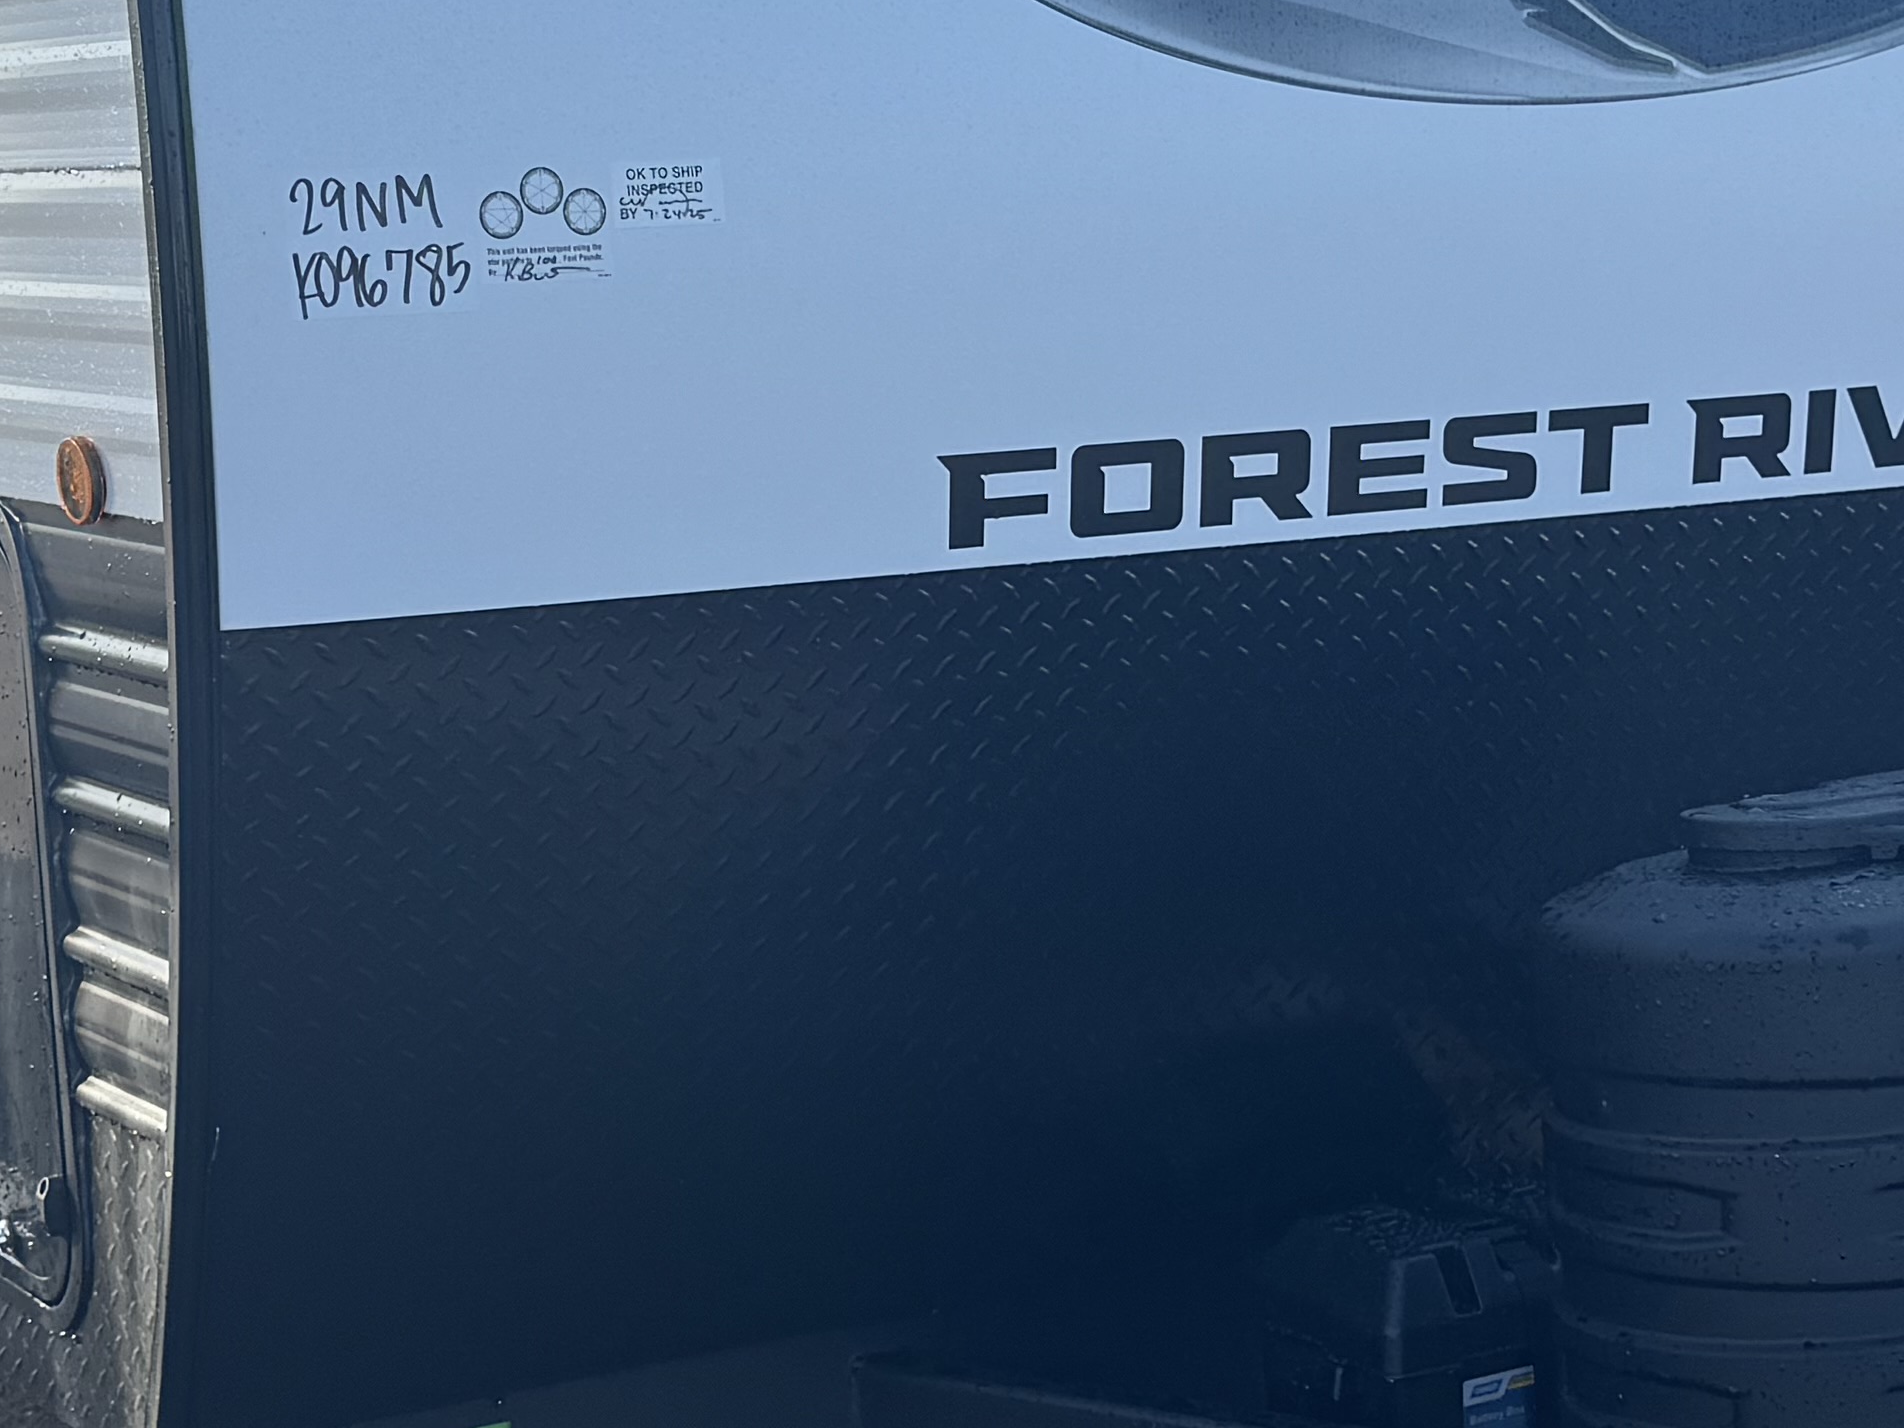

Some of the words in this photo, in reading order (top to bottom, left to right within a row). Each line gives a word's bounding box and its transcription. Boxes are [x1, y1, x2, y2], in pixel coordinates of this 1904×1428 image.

[625, 168, 646, 180] OK
[649, 167, 668, 179] TO
[671, 165, 702, 178] SHIP
[627, 181, 703, 196] INSPECTED
[289, 174, 443, 235] 29NM
[620, 208, 637, 220] BY
[937, 403, 1649, 549] FOREST
